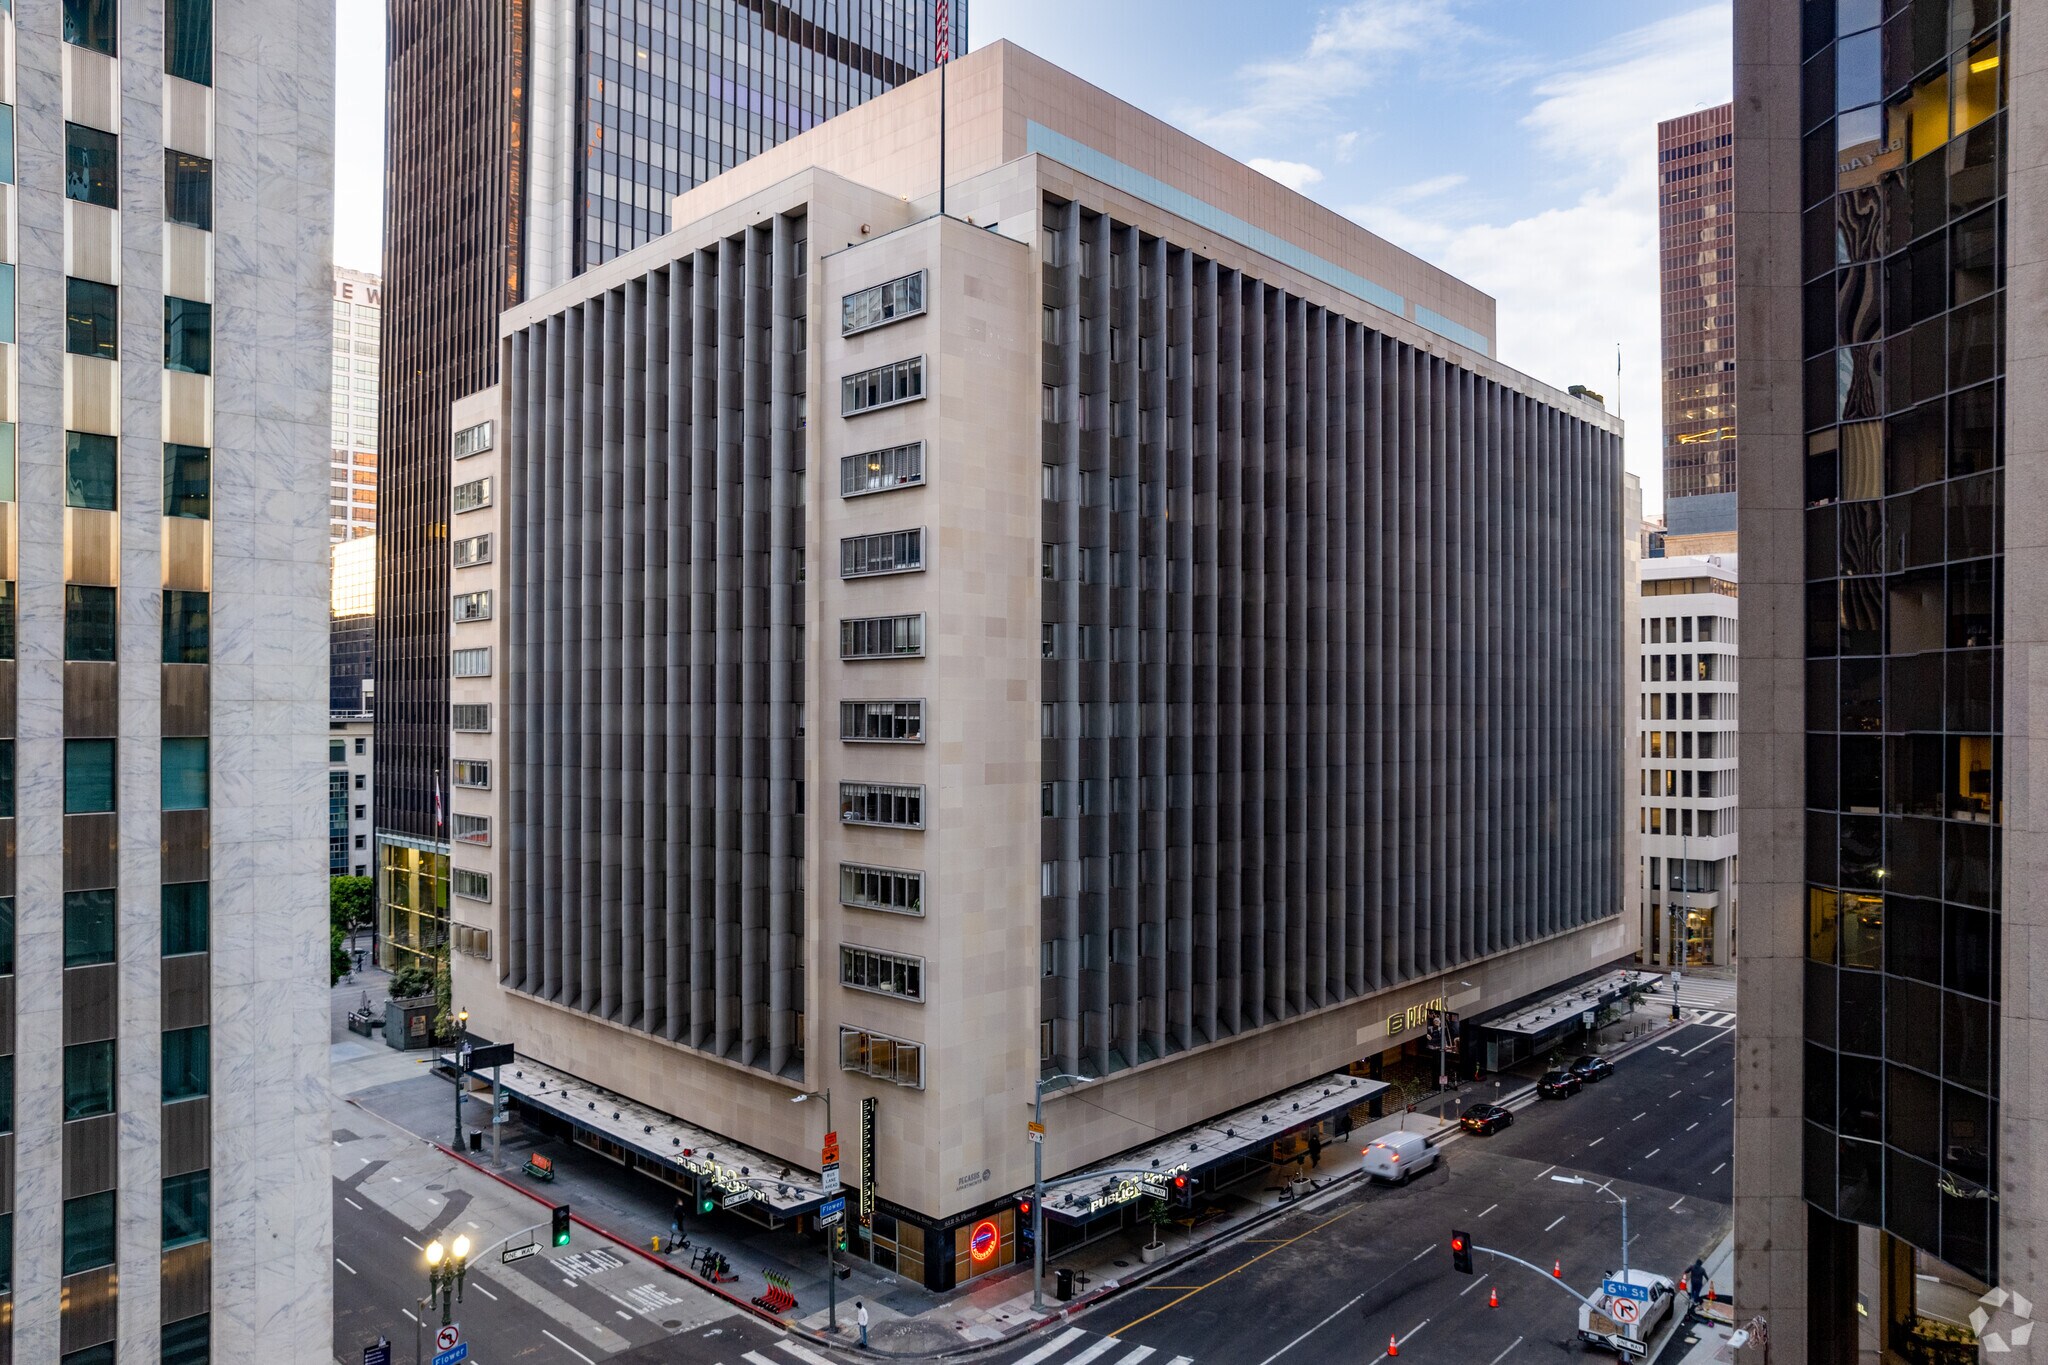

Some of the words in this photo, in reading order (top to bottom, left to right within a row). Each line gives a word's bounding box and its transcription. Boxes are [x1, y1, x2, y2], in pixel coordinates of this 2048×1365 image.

[824, 1182, 839, 1190] AHEAD
[1090, 1185, 1134, 1213] PUBLIC
[822, 1201, 843, 1213] Flower
[504, 1252, 518, 1261] ONE
[521, 1247, 534, 1256] WAY
[551, 1249, 624, 1280] AHEAD
[1607, 1283, 1627, 1293] 6th
[1631, 1288, 1645, 1298] St
[611, 1283, 684, 1315] LANE
[1616, 1339, 1628, 1347] ONE
[1630, 1342, 1642, 1351] WAY
[435, 1348, 465, 1365] Flower
